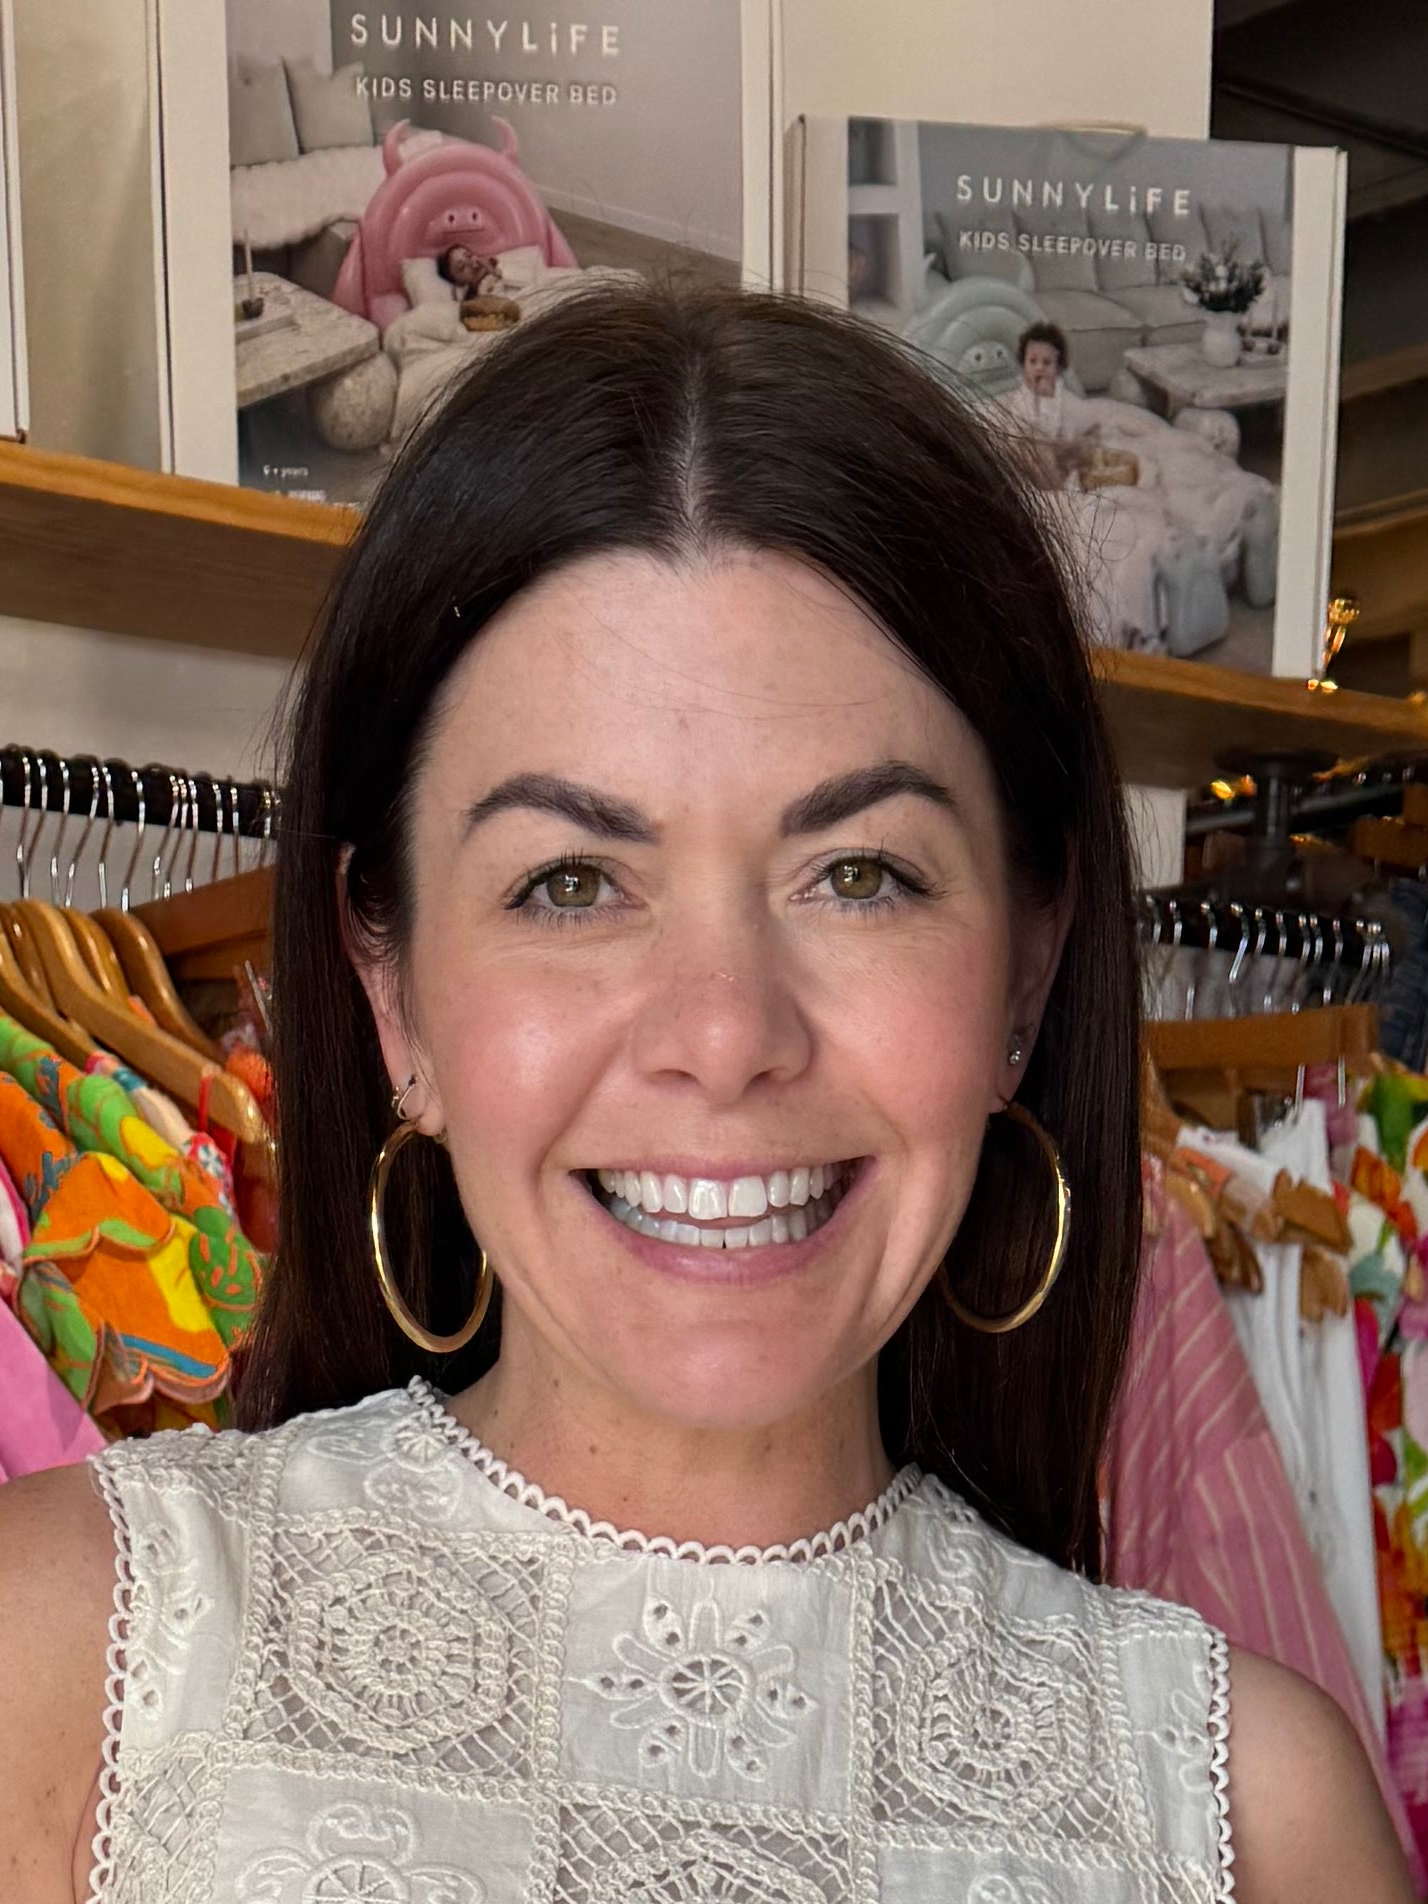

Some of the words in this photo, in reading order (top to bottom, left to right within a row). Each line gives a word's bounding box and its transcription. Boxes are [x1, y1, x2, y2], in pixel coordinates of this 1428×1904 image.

[355, 76, 412, 98] KIDS
[423, 78, 560, 103] SLEEPOVER
[569, 85, 617, 105] BED
[959, 230, 1010, 250] KIDS
[1017, 233, 1137, 259] SLEEPOVER
[1144, 241, 1187, 261] BED
